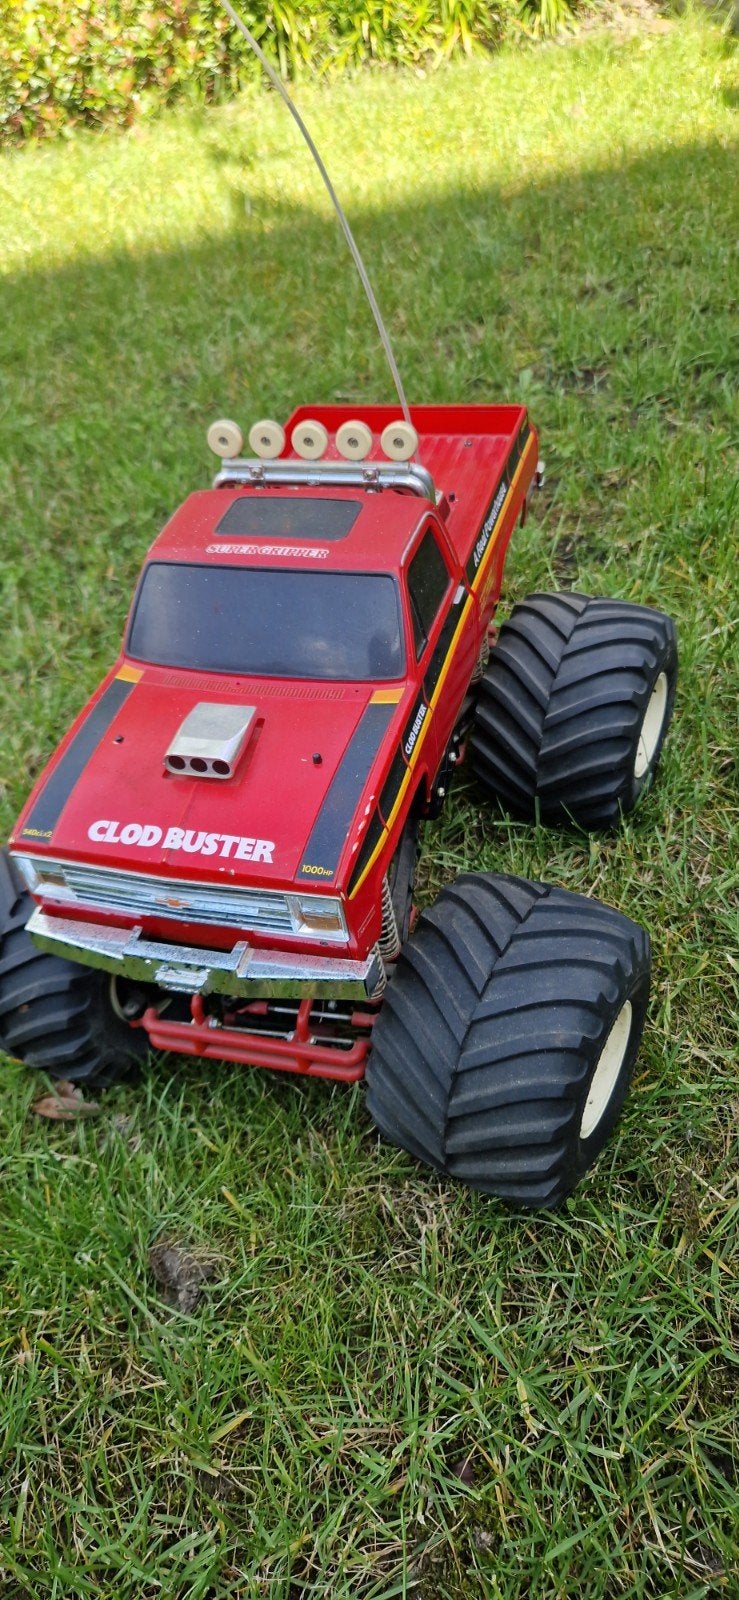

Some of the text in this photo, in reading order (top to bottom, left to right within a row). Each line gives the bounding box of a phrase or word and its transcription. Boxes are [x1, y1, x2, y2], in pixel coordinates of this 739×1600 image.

[205, 544, 330, 559] SUPER GRIPPER
[405, 703, 428, 755] CLOD BUSTER
[87, 819, 276, 864] CLOD BUSTER
